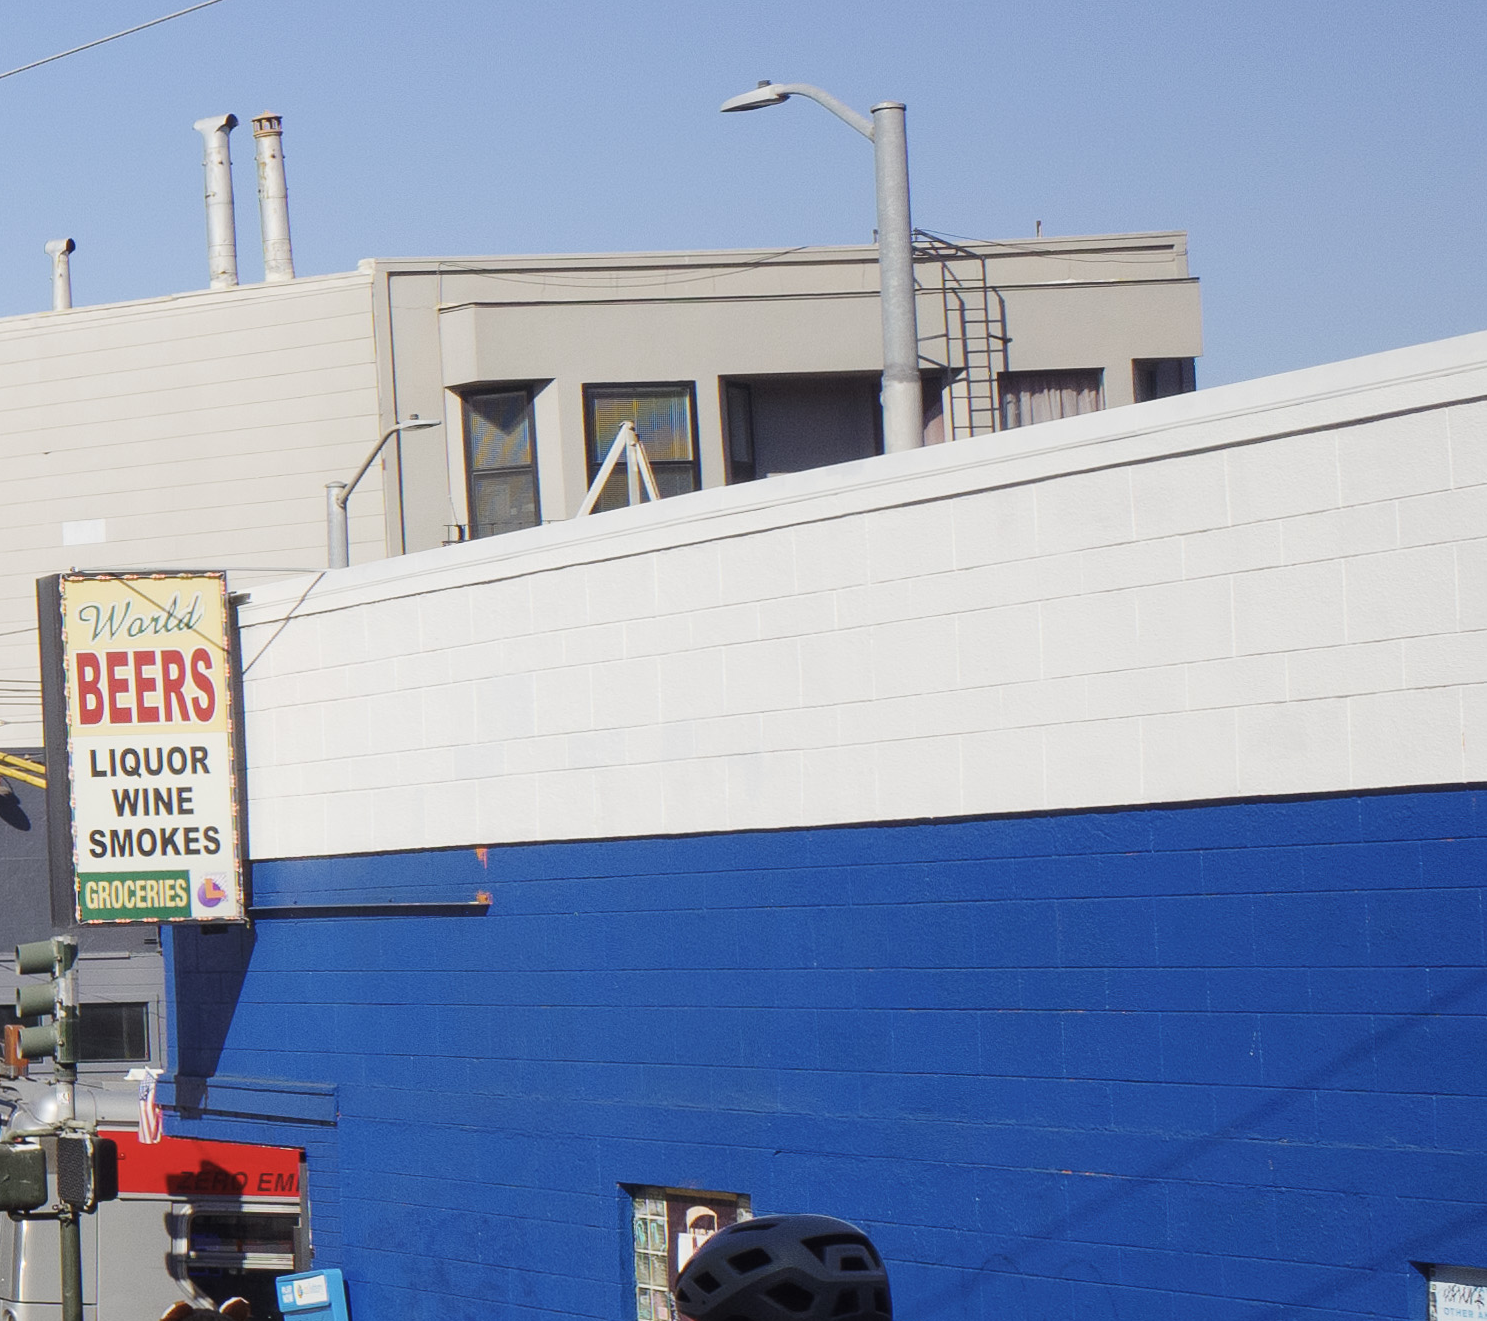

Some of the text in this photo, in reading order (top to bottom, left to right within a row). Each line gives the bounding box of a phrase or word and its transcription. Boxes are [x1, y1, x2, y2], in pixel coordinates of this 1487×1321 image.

[79, 594, 203, 641] World
[75, 647, 216, 725] BEERS
[89, 746, 211, 779] LIQUOR
[111, 786, 195, 817] WINE
[88, 825, 221, 859] SMOKES
[85, 878, 188, 911] GROCERIES
[176, 1171, 249, 1193] ZERO
